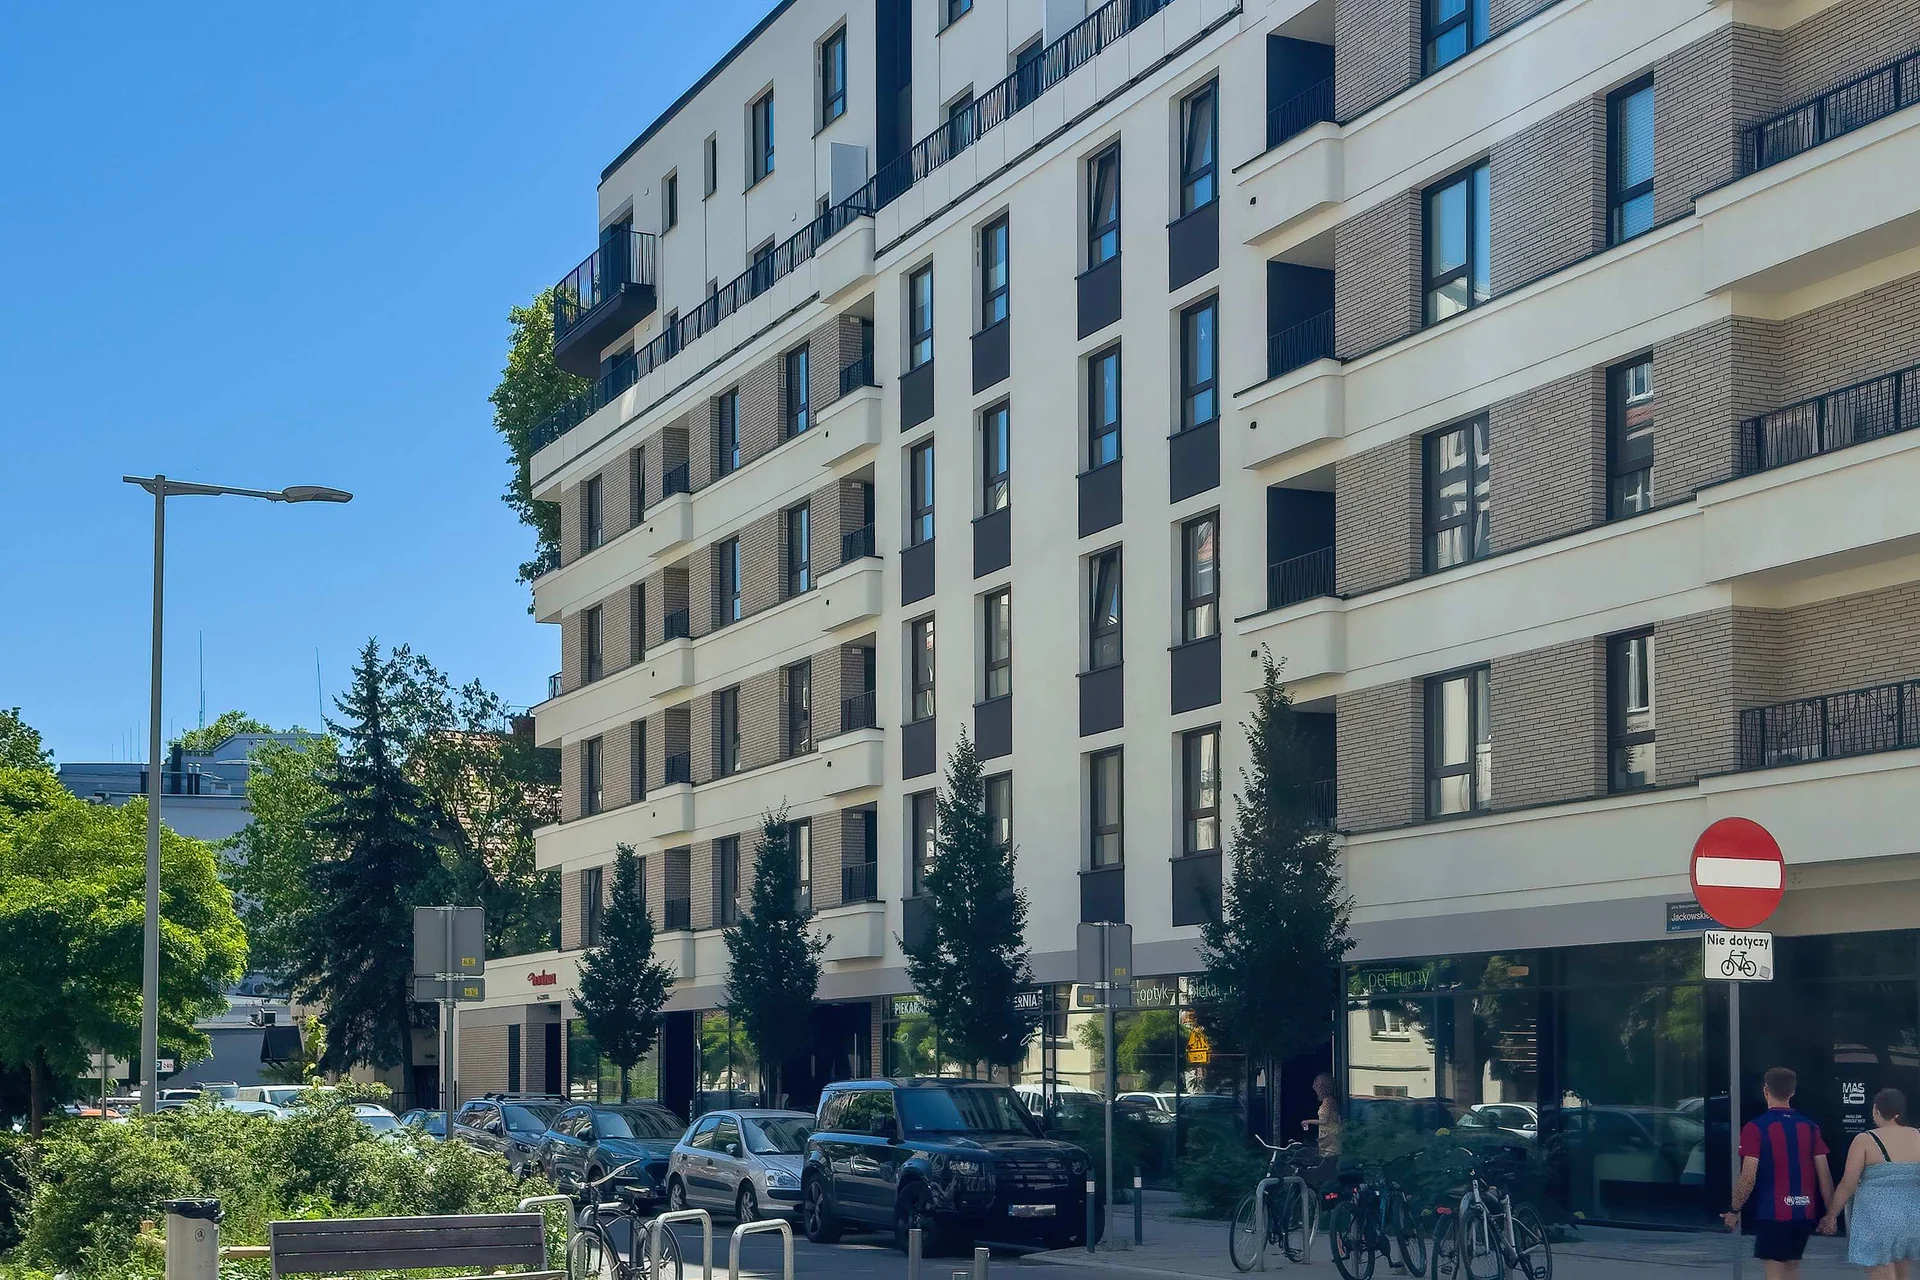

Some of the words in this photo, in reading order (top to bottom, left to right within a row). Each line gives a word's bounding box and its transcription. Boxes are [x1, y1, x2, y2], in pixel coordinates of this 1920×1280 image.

[1707, 933, 1725, 946] Nie
[1729, 934, 1769, 950] dotyczy
[1140, 982, 1169, 1005] optyk
[894, 1001, 925, 1015] PIEKAR
[1842, 1082, 1865, 1093] MAS
